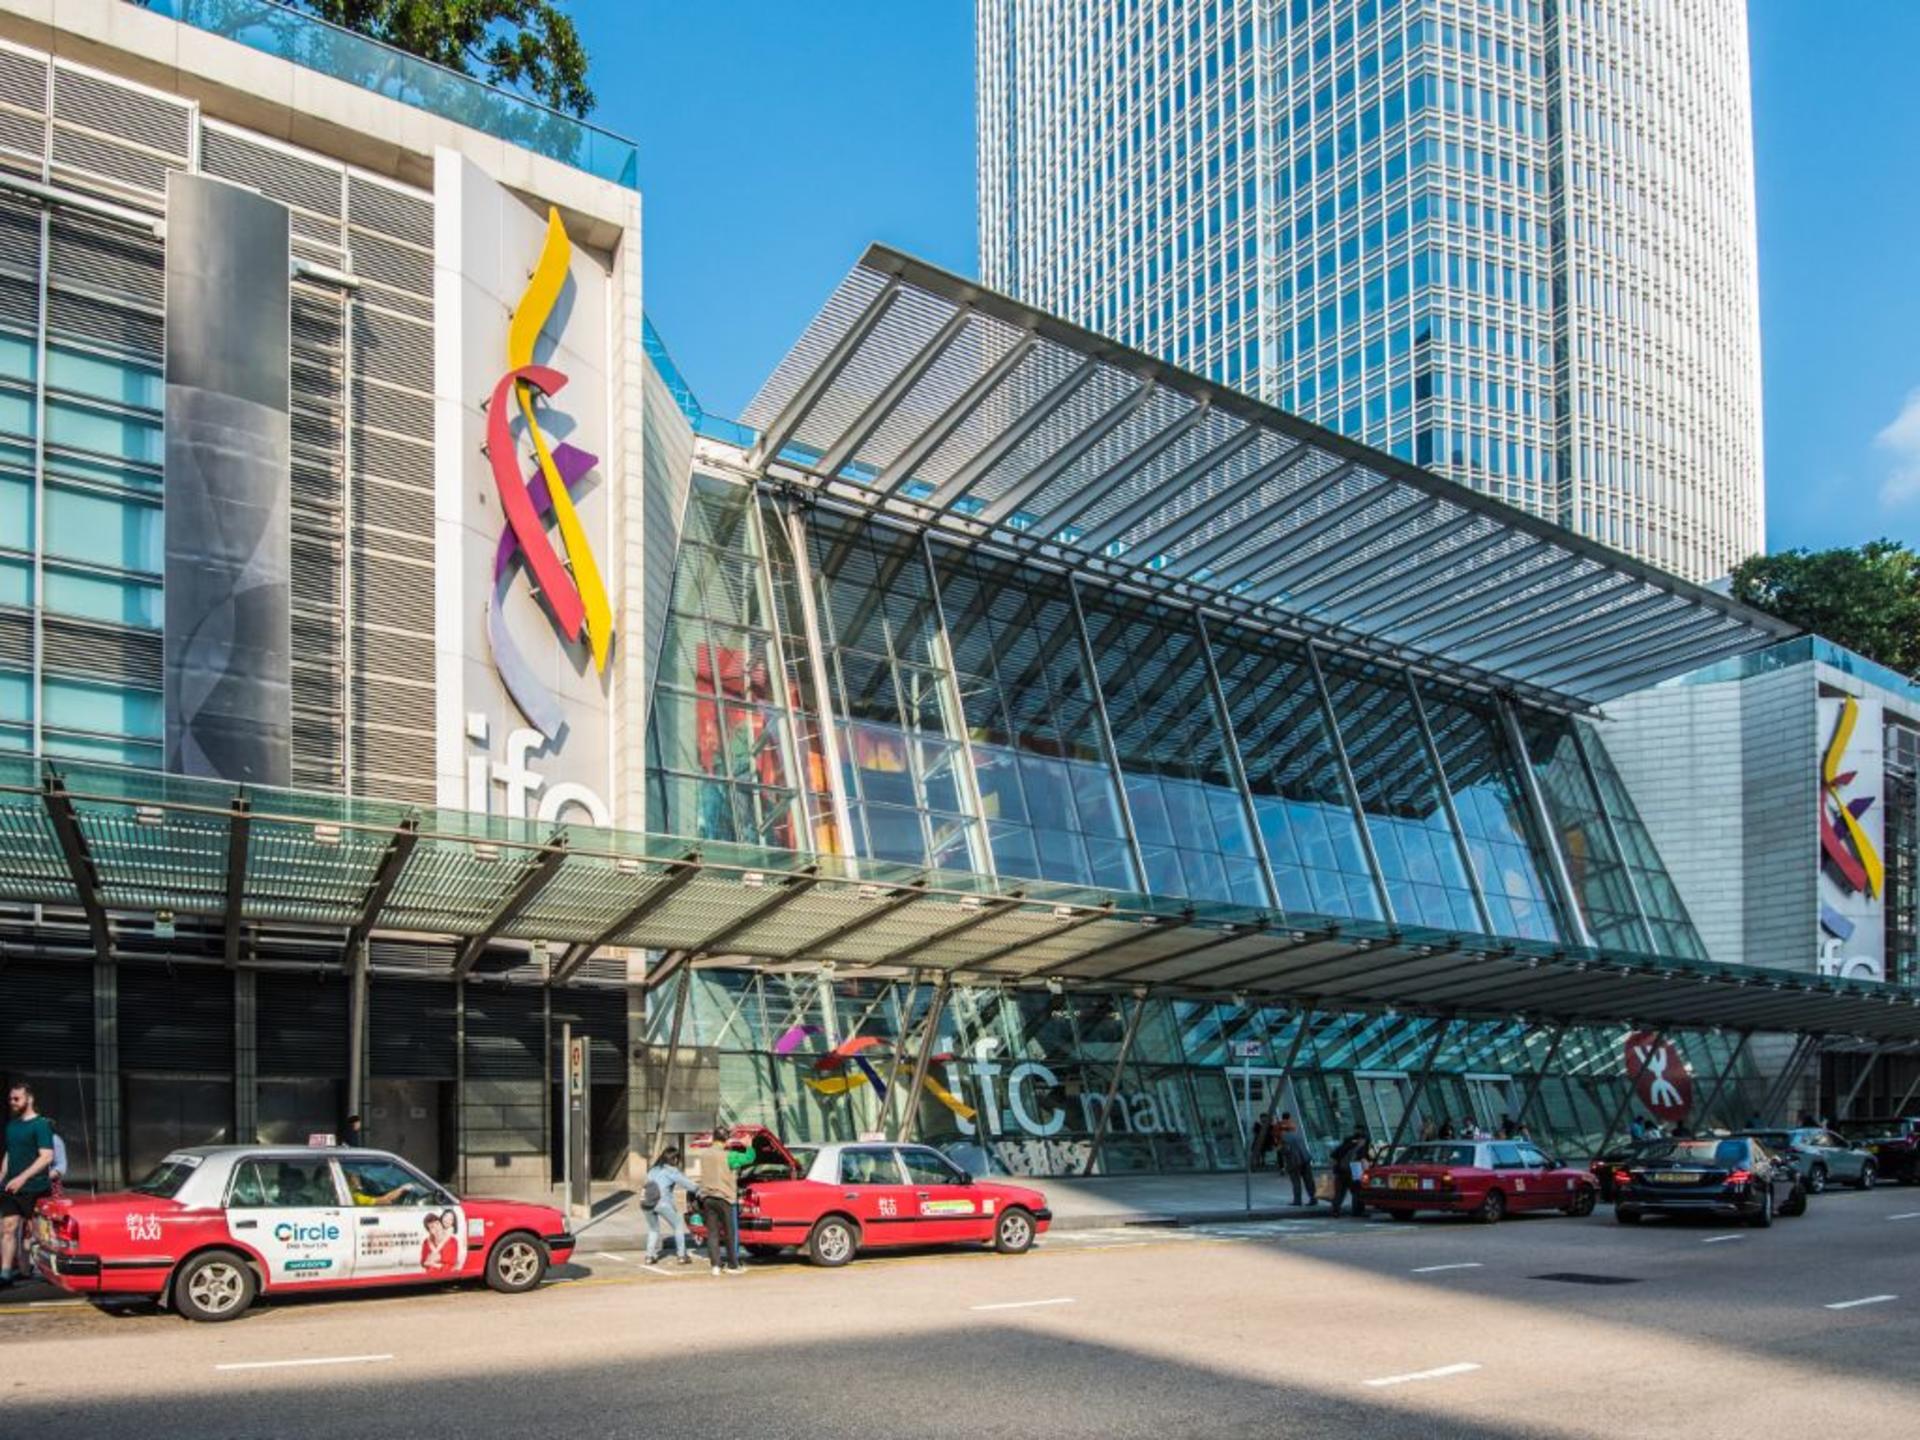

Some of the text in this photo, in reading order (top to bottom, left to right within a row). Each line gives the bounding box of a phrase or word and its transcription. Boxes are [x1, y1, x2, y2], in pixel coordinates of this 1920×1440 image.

[940, 1037, 1187, 1135] ifc mall
[125, 1212, 160, 1226] 的士
[128, 1225, 162, 1241] TAXI
[274, 1222, 340, 1241] Circle
